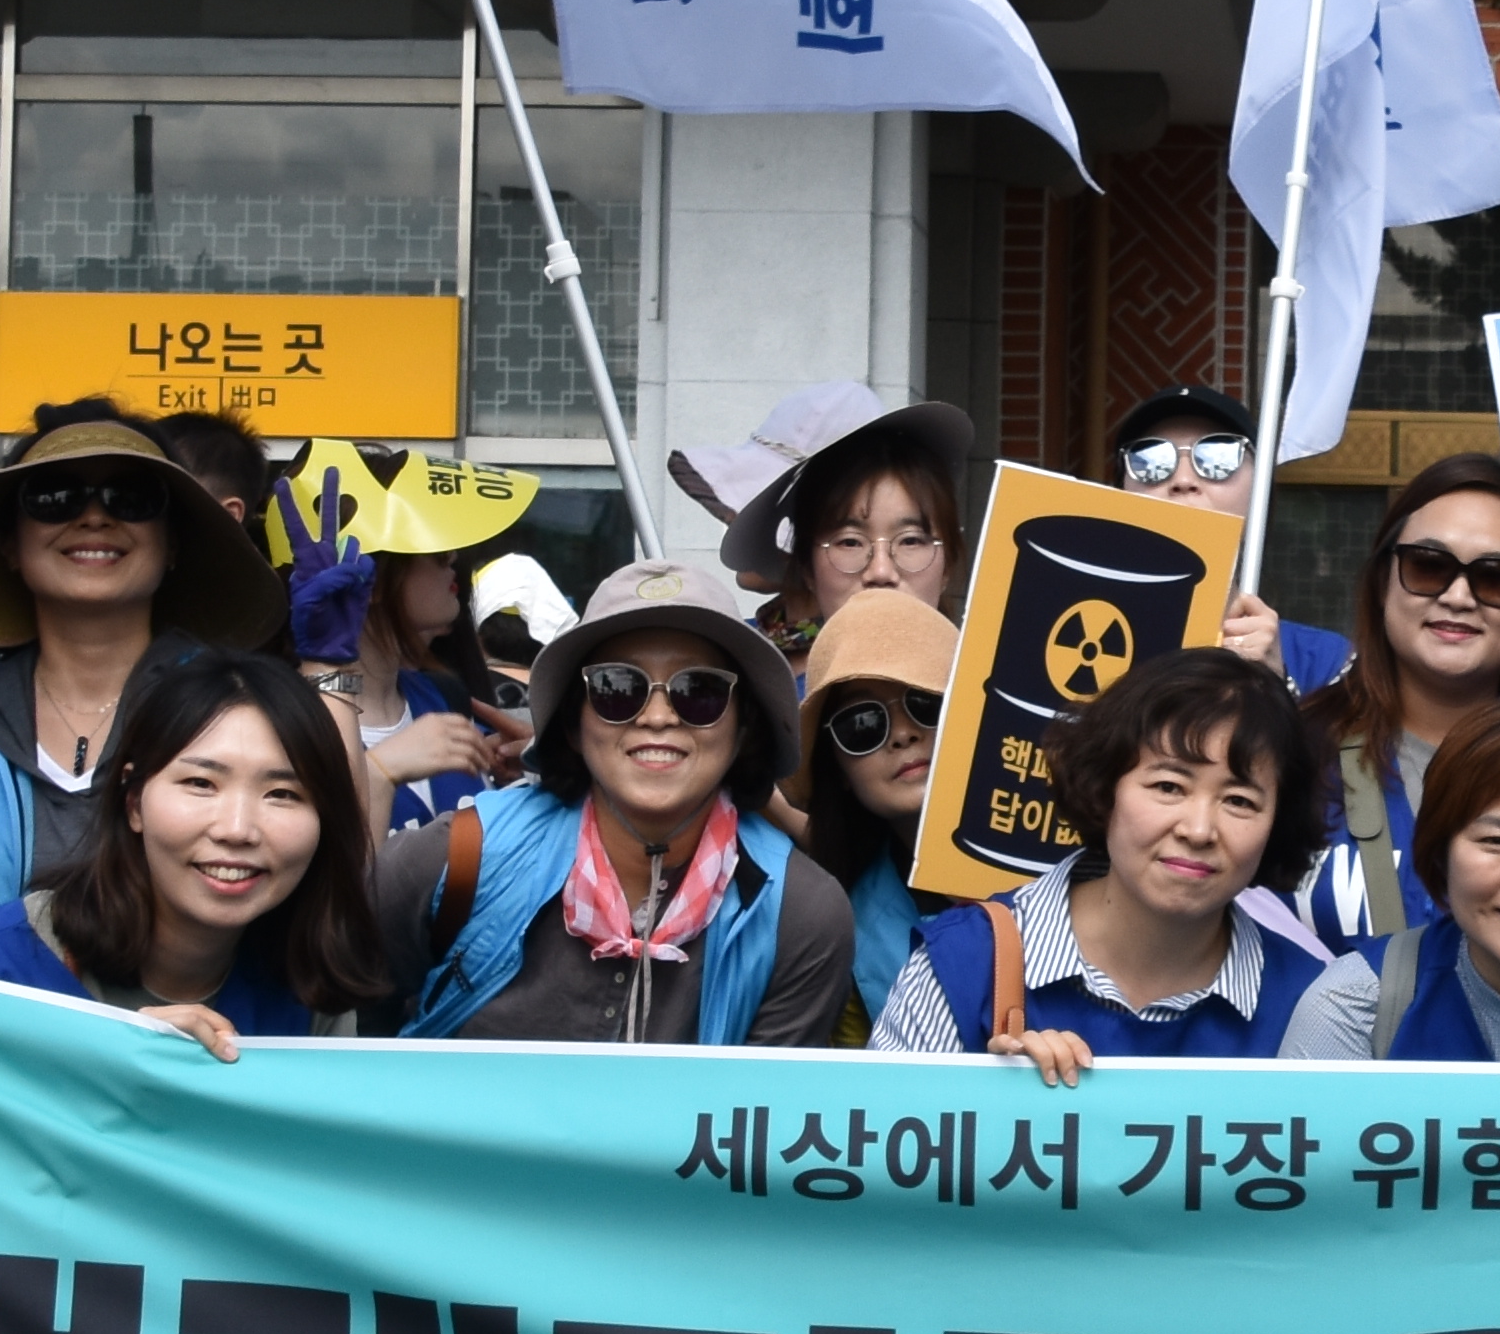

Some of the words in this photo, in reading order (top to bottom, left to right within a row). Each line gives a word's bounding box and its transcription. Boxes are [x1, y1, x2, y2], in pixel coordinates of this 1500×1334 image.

[128, 320, 264, 373] 나오는
[283, 323, 325, 375] 곳
[158, 383, 207, 409] Exit
[230, 384, 277, 408] 出口
[675, 1108, 1084, 1210] 세상에서
[1117, 1112, 1320, 1213] 가장
